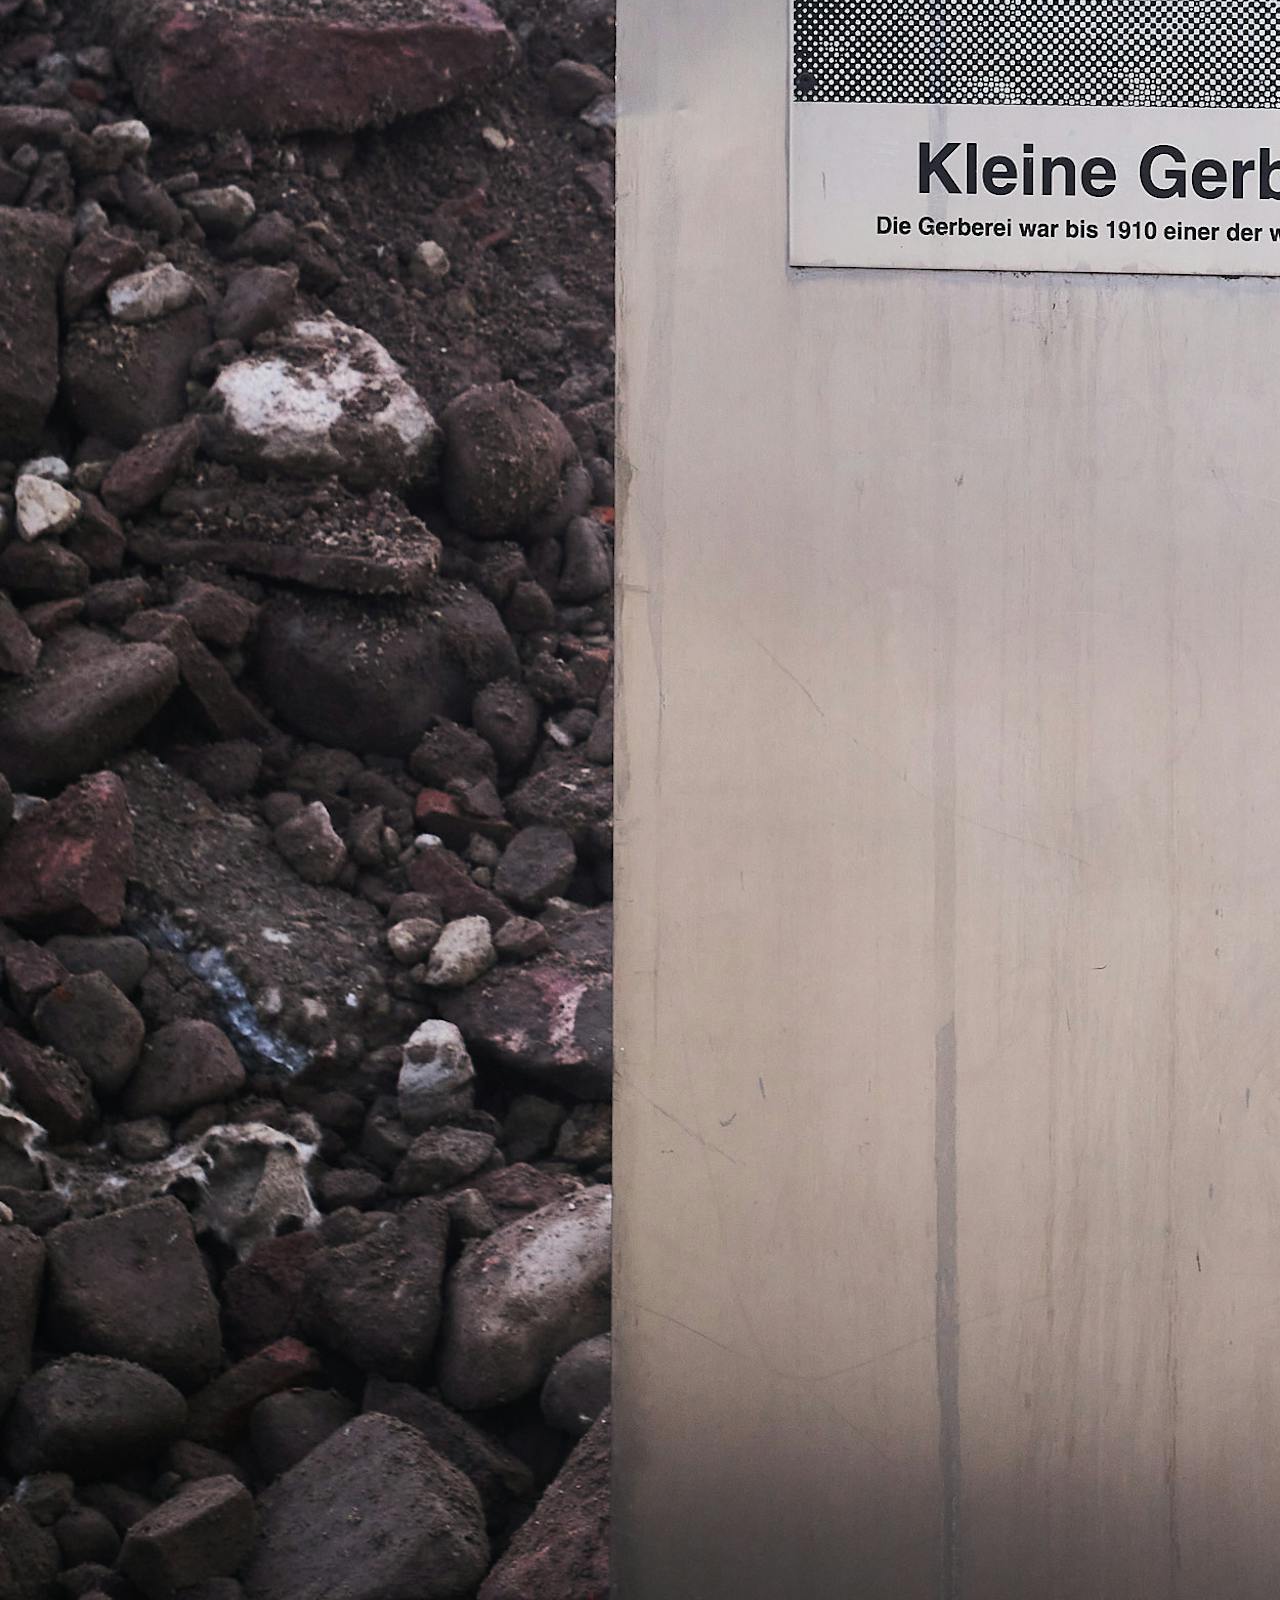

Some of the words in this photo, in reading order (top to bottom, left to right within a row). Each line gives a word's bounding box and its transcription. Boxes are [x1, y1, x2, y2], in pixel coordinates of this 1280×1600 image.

[918, 141, 1117, 198] Kleine
[876, 215, 912, 235] Die
[918, 216, 1012, 237] Gerberei
[1018, 222, 1059, 238] war
[1065, 219, 1099, 239] bis
[1106, 220, 1157, 240] 1910
[1163, 221, 1220, 241] einer
[1226, 222, 1263, 242] der
